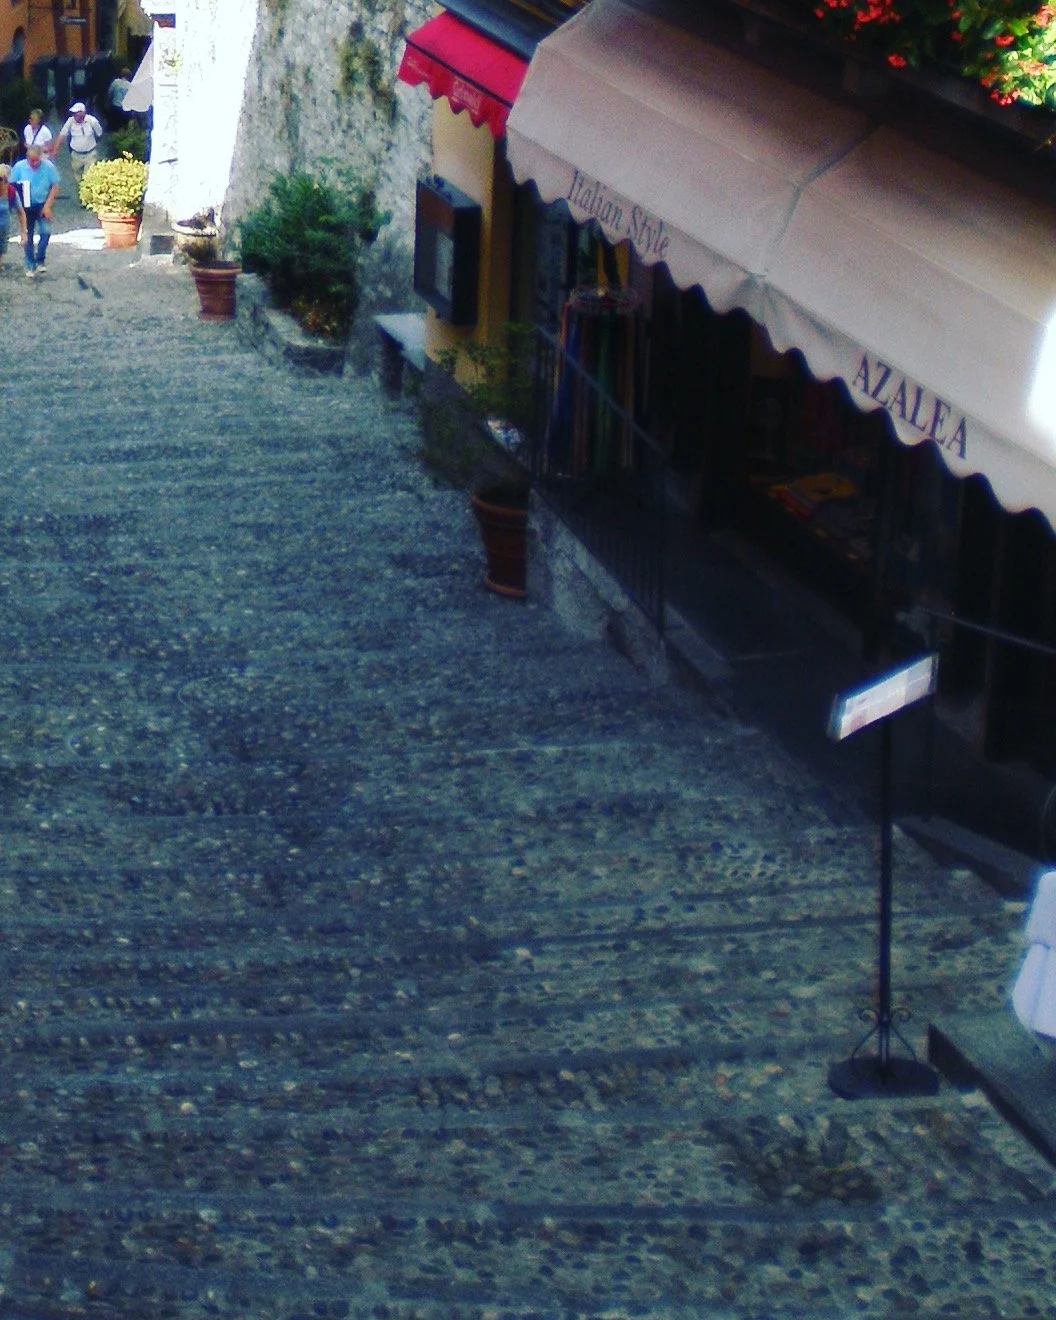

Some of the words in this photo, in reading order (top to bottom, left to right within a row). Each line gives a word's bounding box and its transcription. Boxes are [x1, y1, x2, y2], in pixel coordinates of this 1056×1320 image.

[567, 167, 624, 231] Italian
[626, 203, 670, 259] Style
[851, 352, 967, 460] AZALEA
